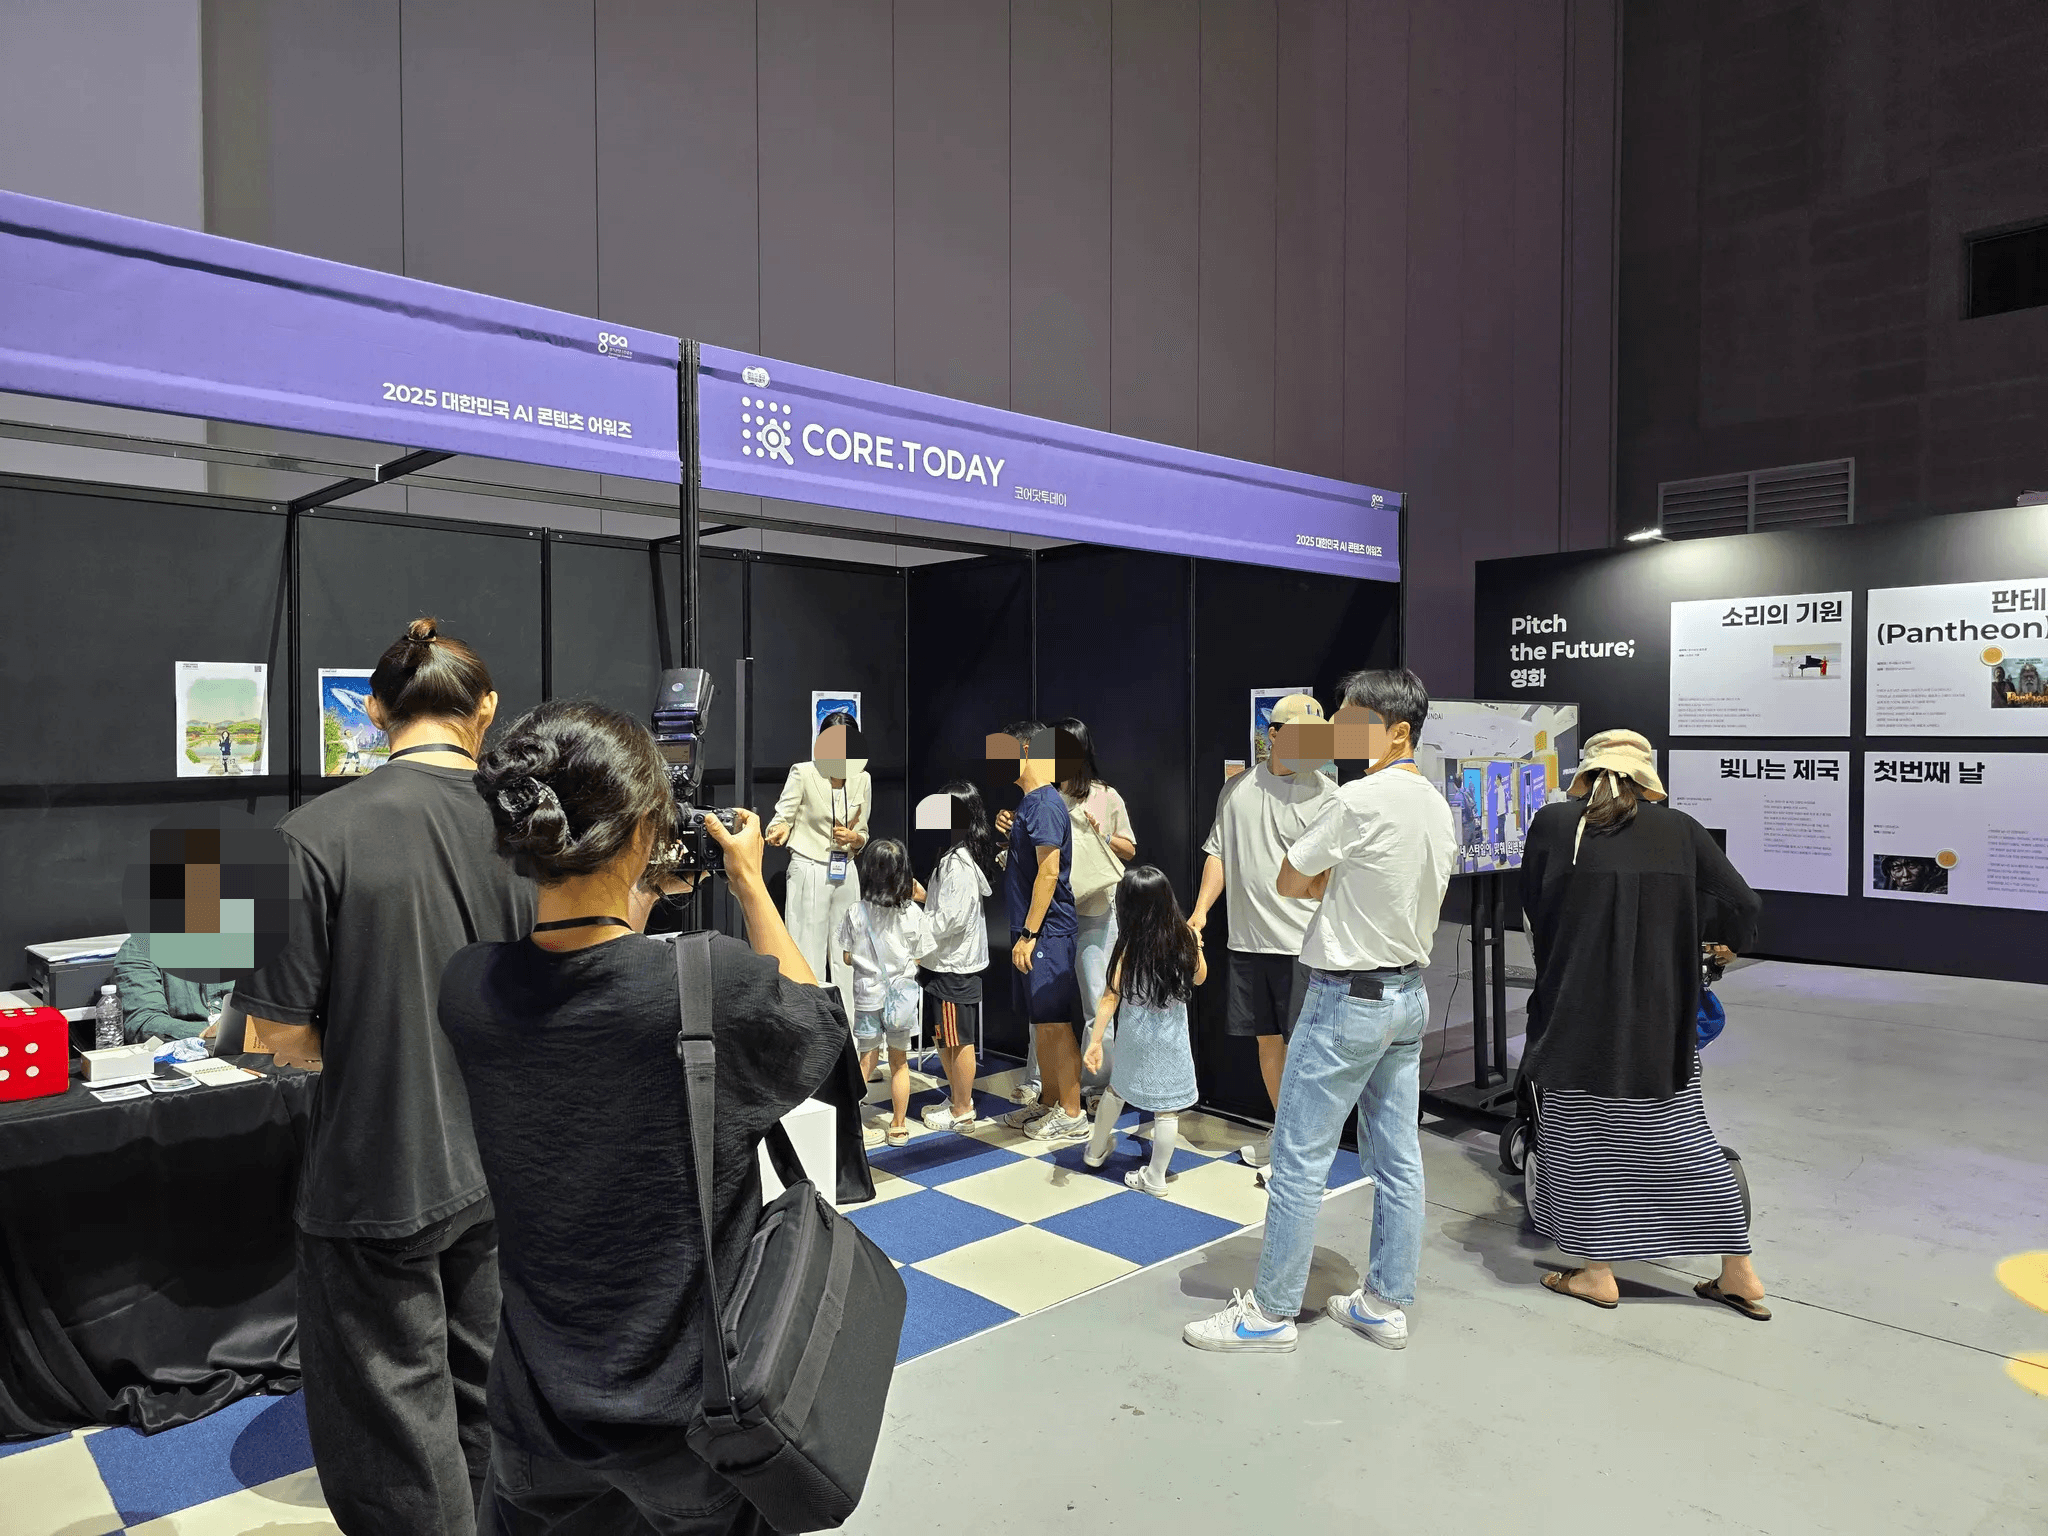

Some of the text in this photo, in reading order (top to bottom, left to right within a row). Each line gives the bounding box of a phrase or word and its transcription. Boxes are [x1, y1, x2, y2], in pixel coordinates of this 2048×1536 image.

[382, 382, 633, 439] 2025 대한민국 AI 콘텐츠 어워즈
[802, 423, 1005, 487] CORE.TODAY
[1014, 485, 1067, 507] 코어닷투데이
[1296, 534, 1383, 557] 2025 대한민국 AI 콘텐츠 어워즈
[1511, 614, 1567, 635] Pitch
[1721, 600, 1842, 627] 소리의 기원
[1510, 639, 1636, 661] the Future;
[1510, 668, 1547, 688] 영화
[1720, 758, 1840, 782] 빛나는 제국
[1874, 760, 1986, 784] 첫번째 날
